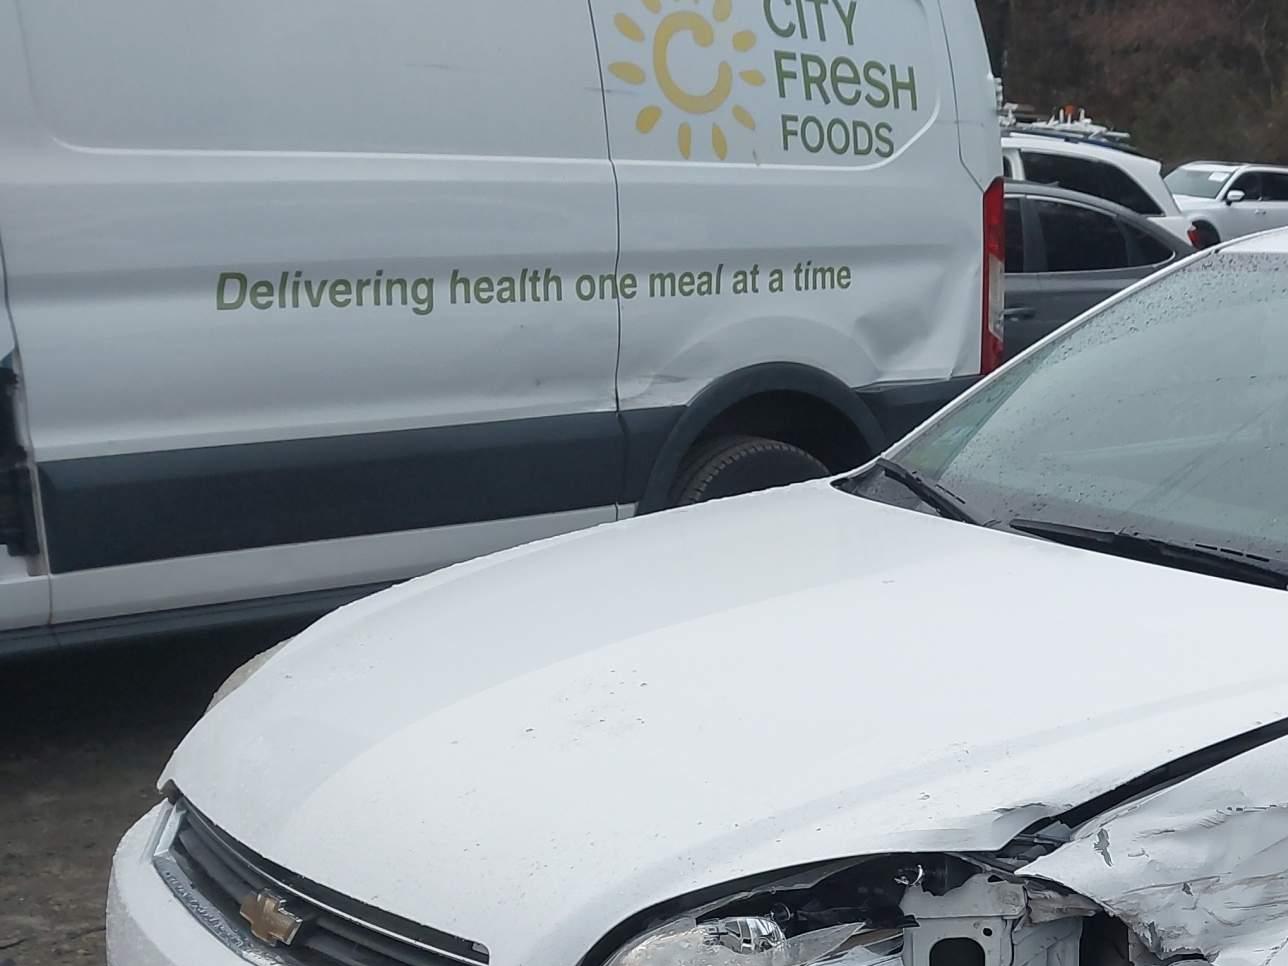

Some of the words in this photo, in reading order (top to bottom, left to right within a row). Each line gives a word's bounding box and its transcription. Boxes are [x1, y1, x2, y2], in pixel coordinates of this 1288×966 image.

[762, 0, 857, 46] CITY
[780, 113, 895, 159] FOODS
[216, 269, 434, 316] Delivering
[449, 265, 563, 306] health
[574, 272, 638, 302] one
[649, 262, 724, 297] meal
[732, 264, 760, 294] at
[767, 269, 785, 293] a
[792, 260, 852, 291] time
